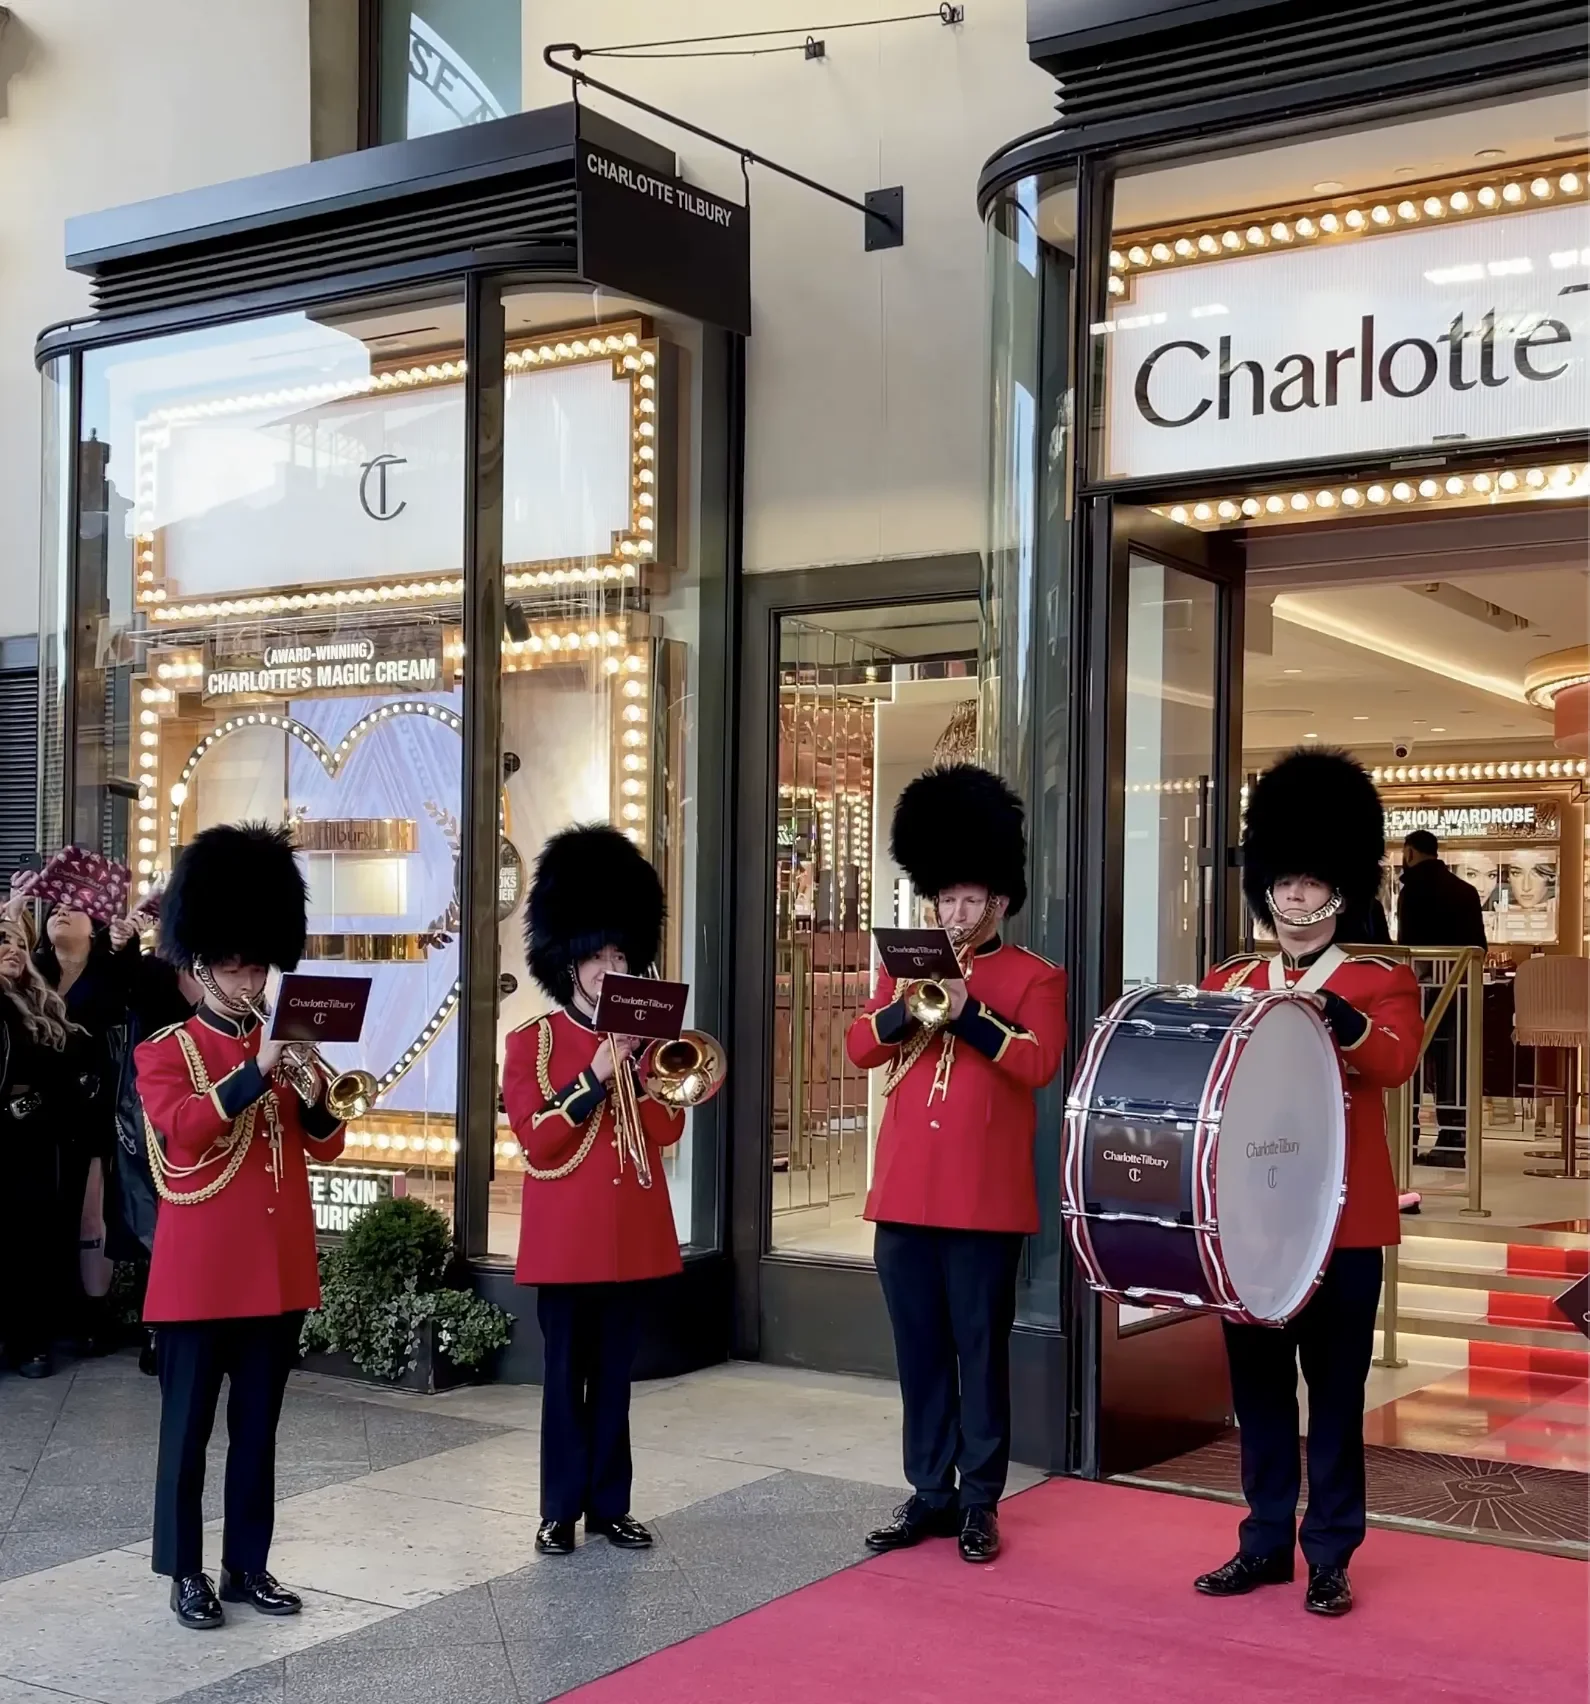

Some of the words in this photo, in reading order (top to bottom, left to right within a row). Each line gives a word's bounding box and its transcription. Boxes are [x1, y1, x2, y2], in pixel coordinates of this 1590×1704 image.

[587, 153, 674, 205] CHARLOTTE
[676, 189, 732, 227] TILBURY
[1134, 307, 1572, 428] Charlotte
[263, 638, 375, 668] (AWARD-WINNING)
[208, 666, 312, 694] CHARLOTTE'S
[317, 662, 371, 687] MAGIC
[375, 658, 436, 682] CREAM
[1443, 807, 1535, 824] WARDROBE
[330, 1177, 378, 1205] SKIN
